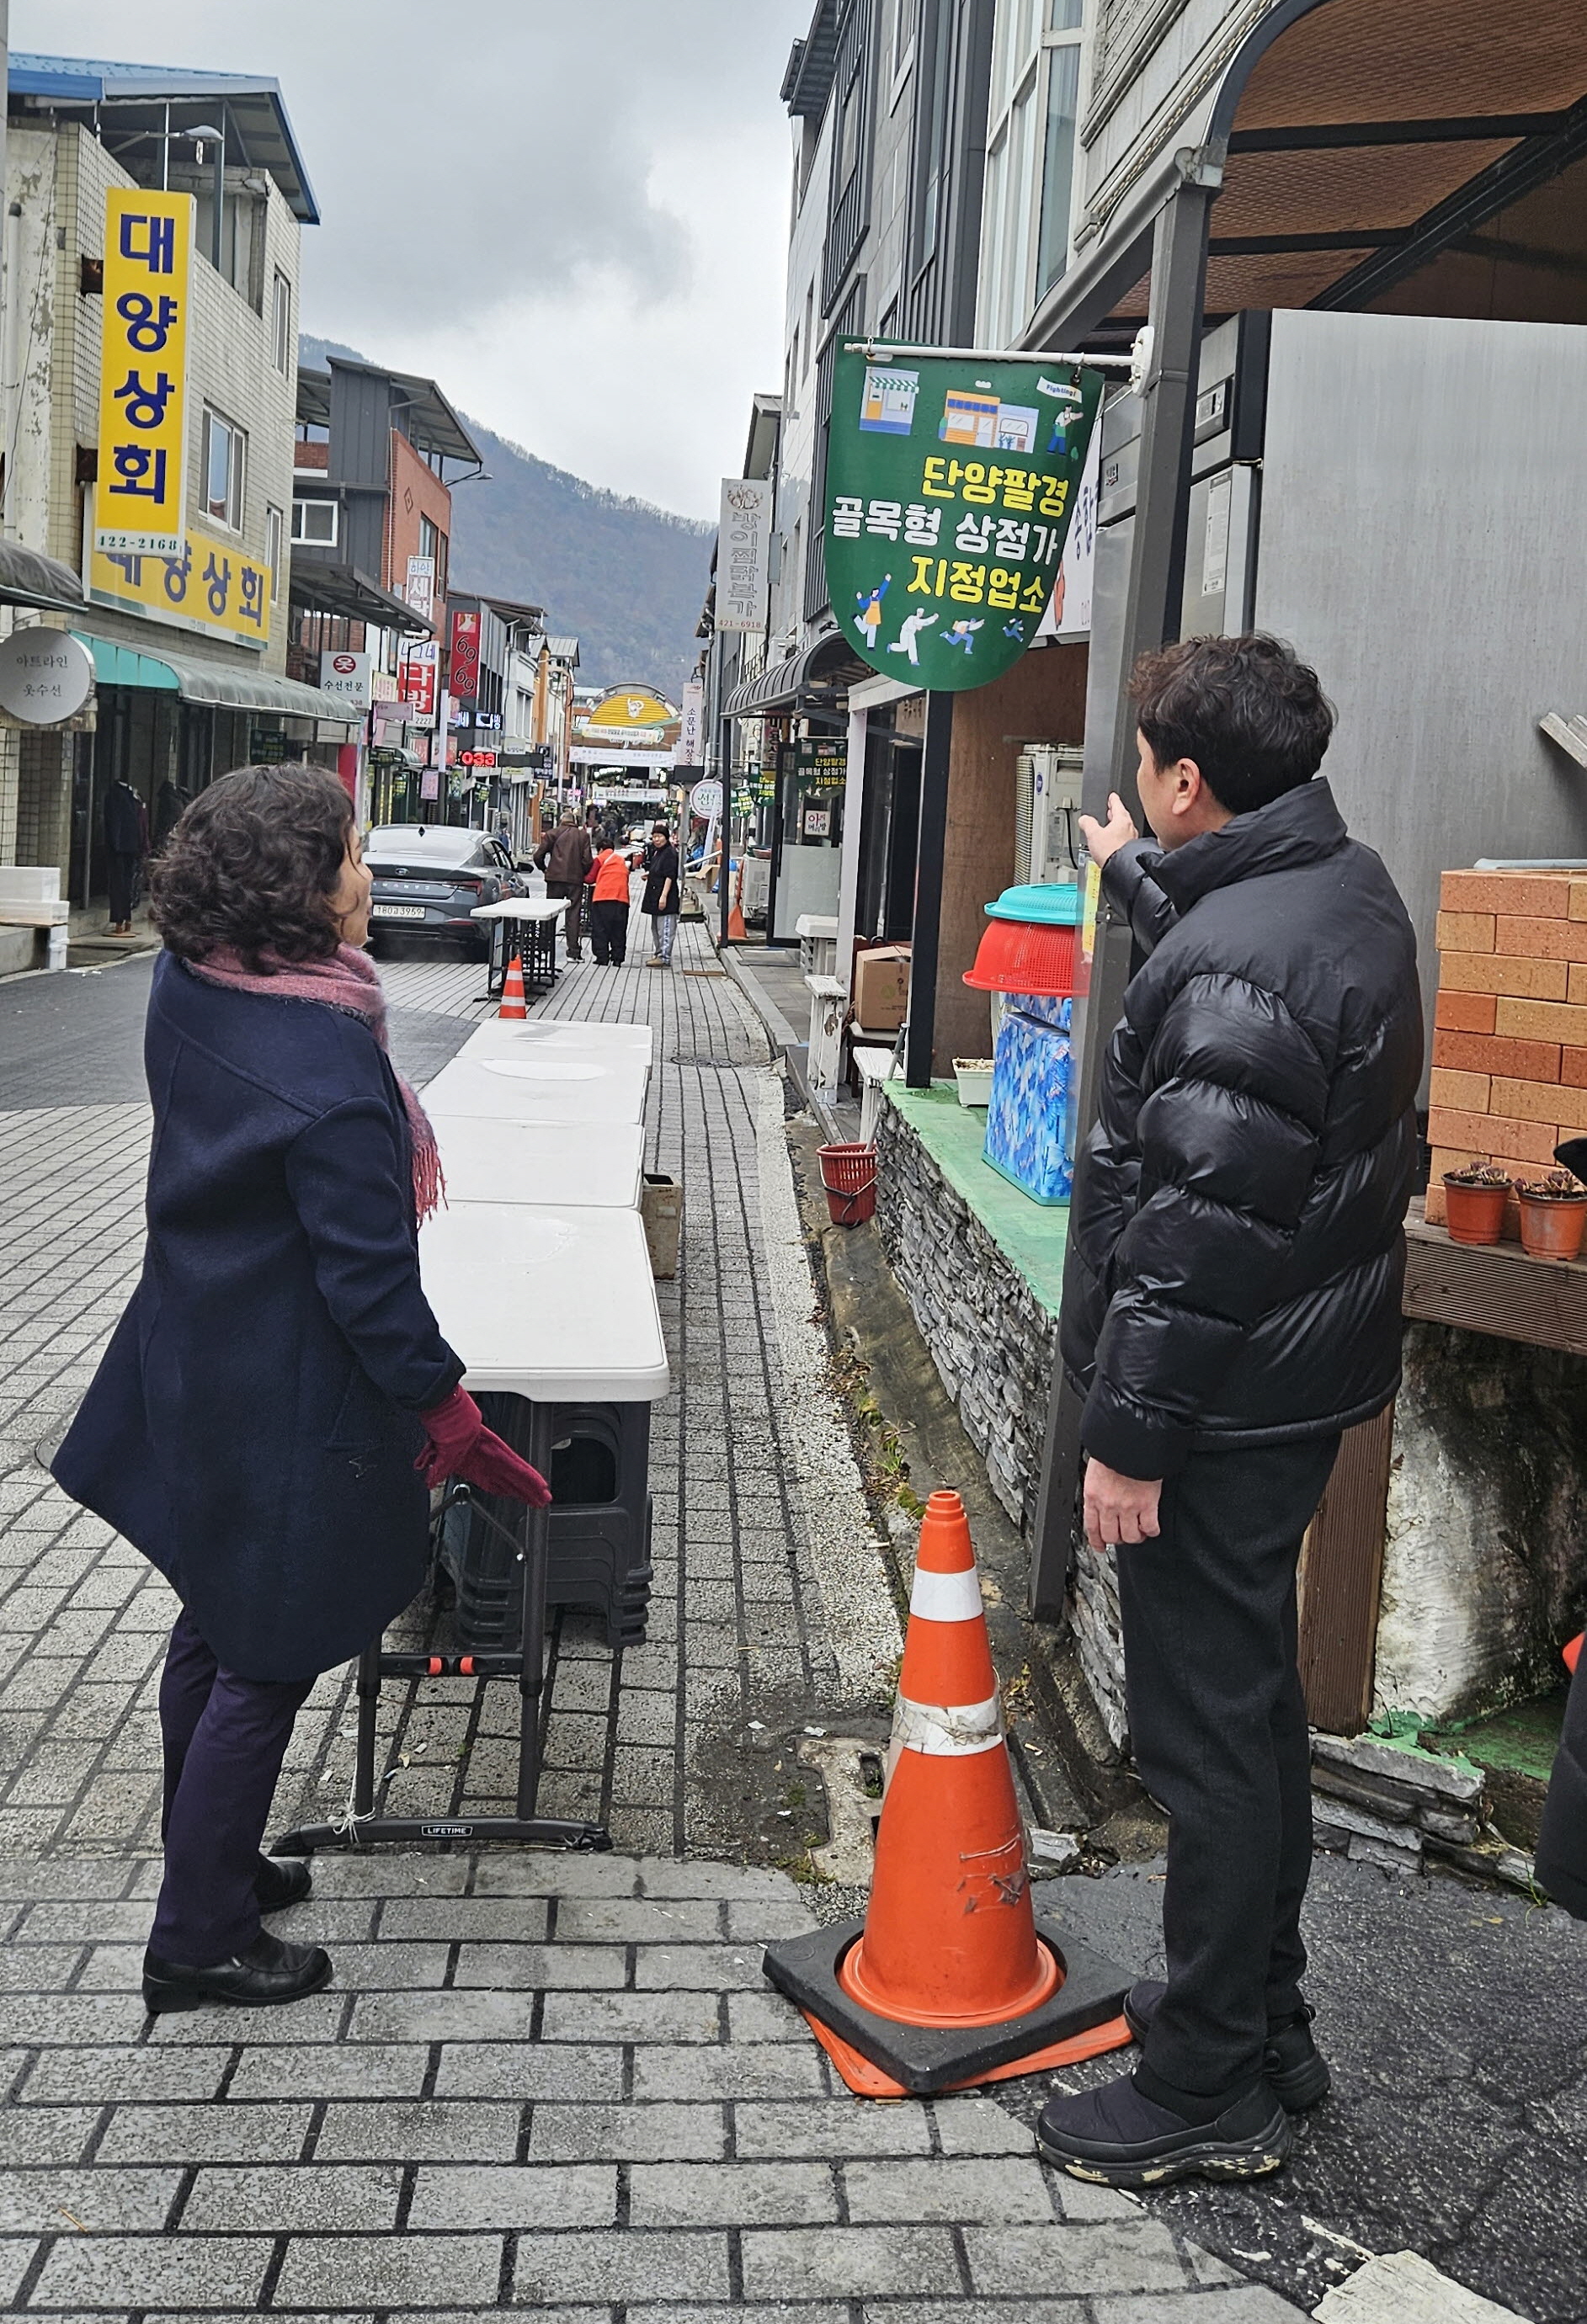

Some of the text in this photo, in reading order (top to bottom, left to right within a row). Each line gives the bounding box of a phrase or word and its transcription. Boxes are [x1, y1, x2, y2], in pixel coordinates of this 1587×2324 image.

[109, 213, 177, 505] 대양상회
[1046, 384, 1077, 396] Fighting!
[922, 455, 1069, 518] 단양팔경
[831, 496, 1058, 566] 골목형 상점가
[98, 535, 178, 550] 422-2168
[907, 556, 1046, 614] 지정업소
[718, 620, 762, 629] 421-6918
[17, 652, 68, 667] 아트라인
[324, 680, 363, 692] 수선전문
[686, 707, 697, 736] 소문난
[427, 1827, 466, 1835] LIFETIME
